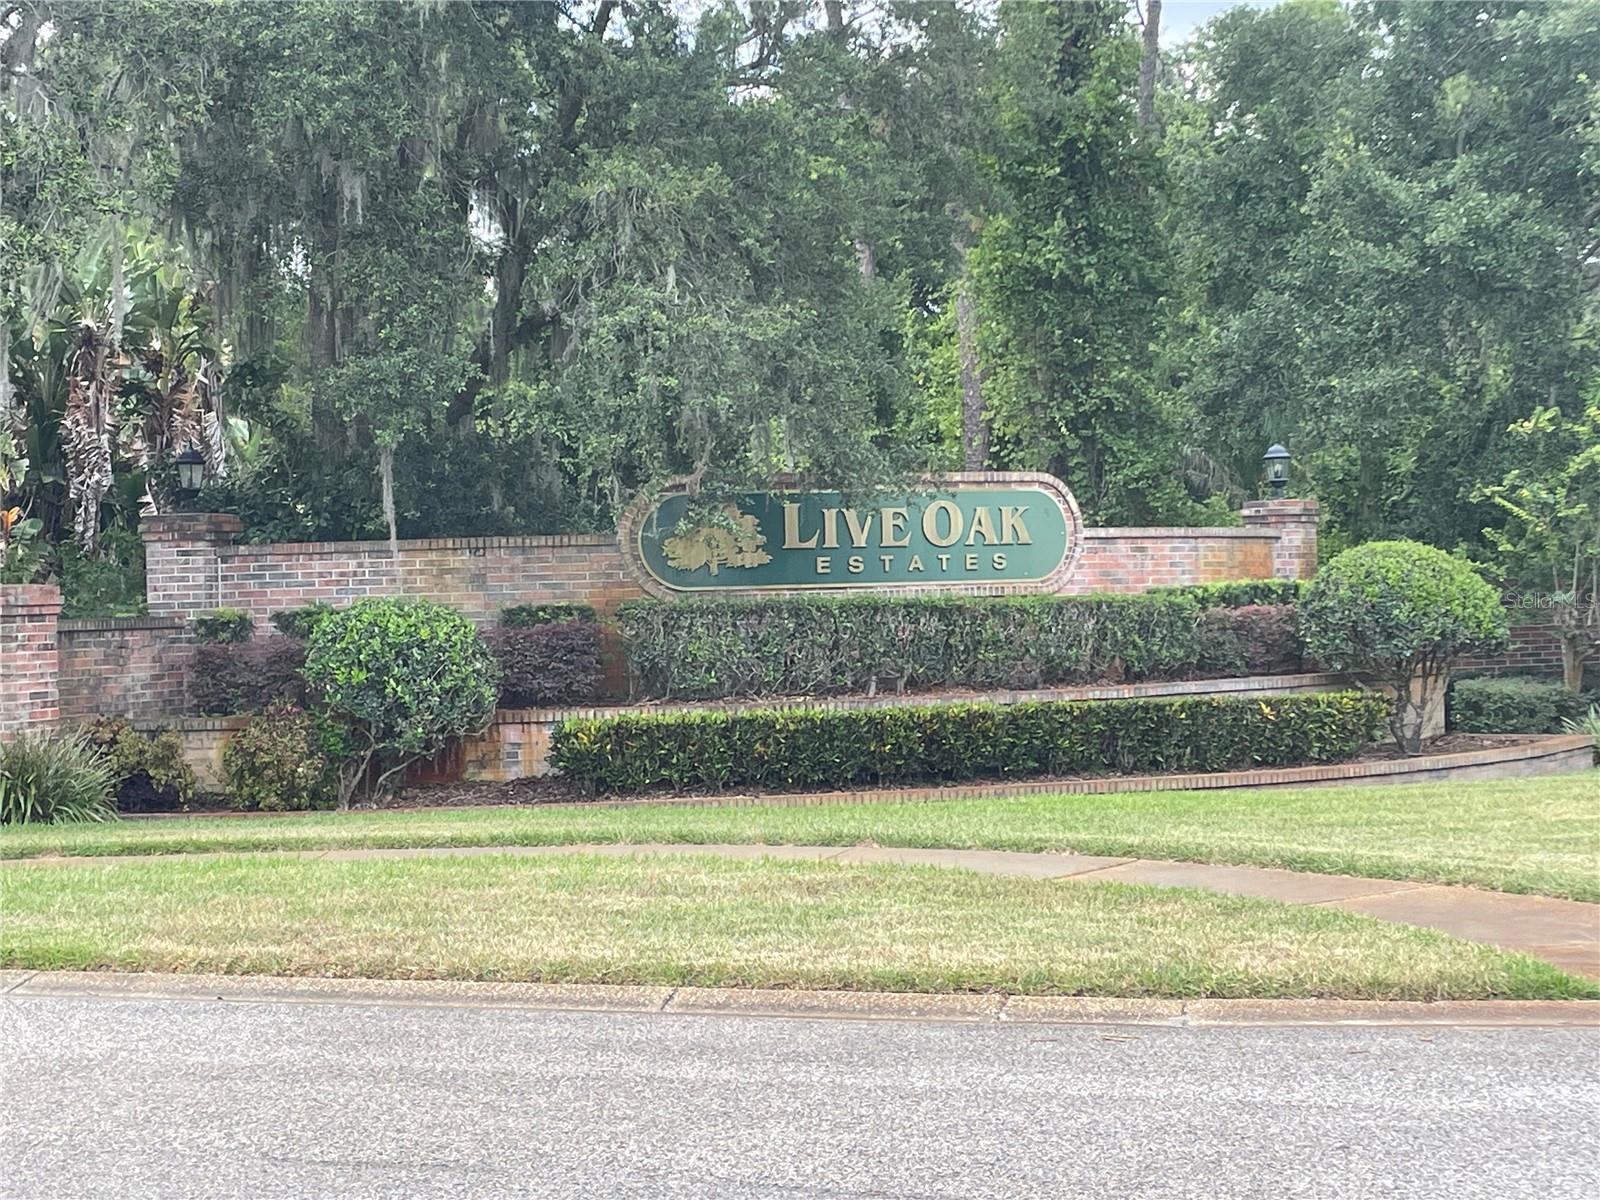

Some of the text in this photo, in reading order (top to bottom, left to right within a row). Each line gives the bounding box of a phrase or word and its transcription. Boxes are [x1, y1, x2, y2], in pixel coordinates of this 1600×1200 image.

[781, 499, 1032, 549] LIVE OAK
[816, 552, 1008, 574] ESTATES
